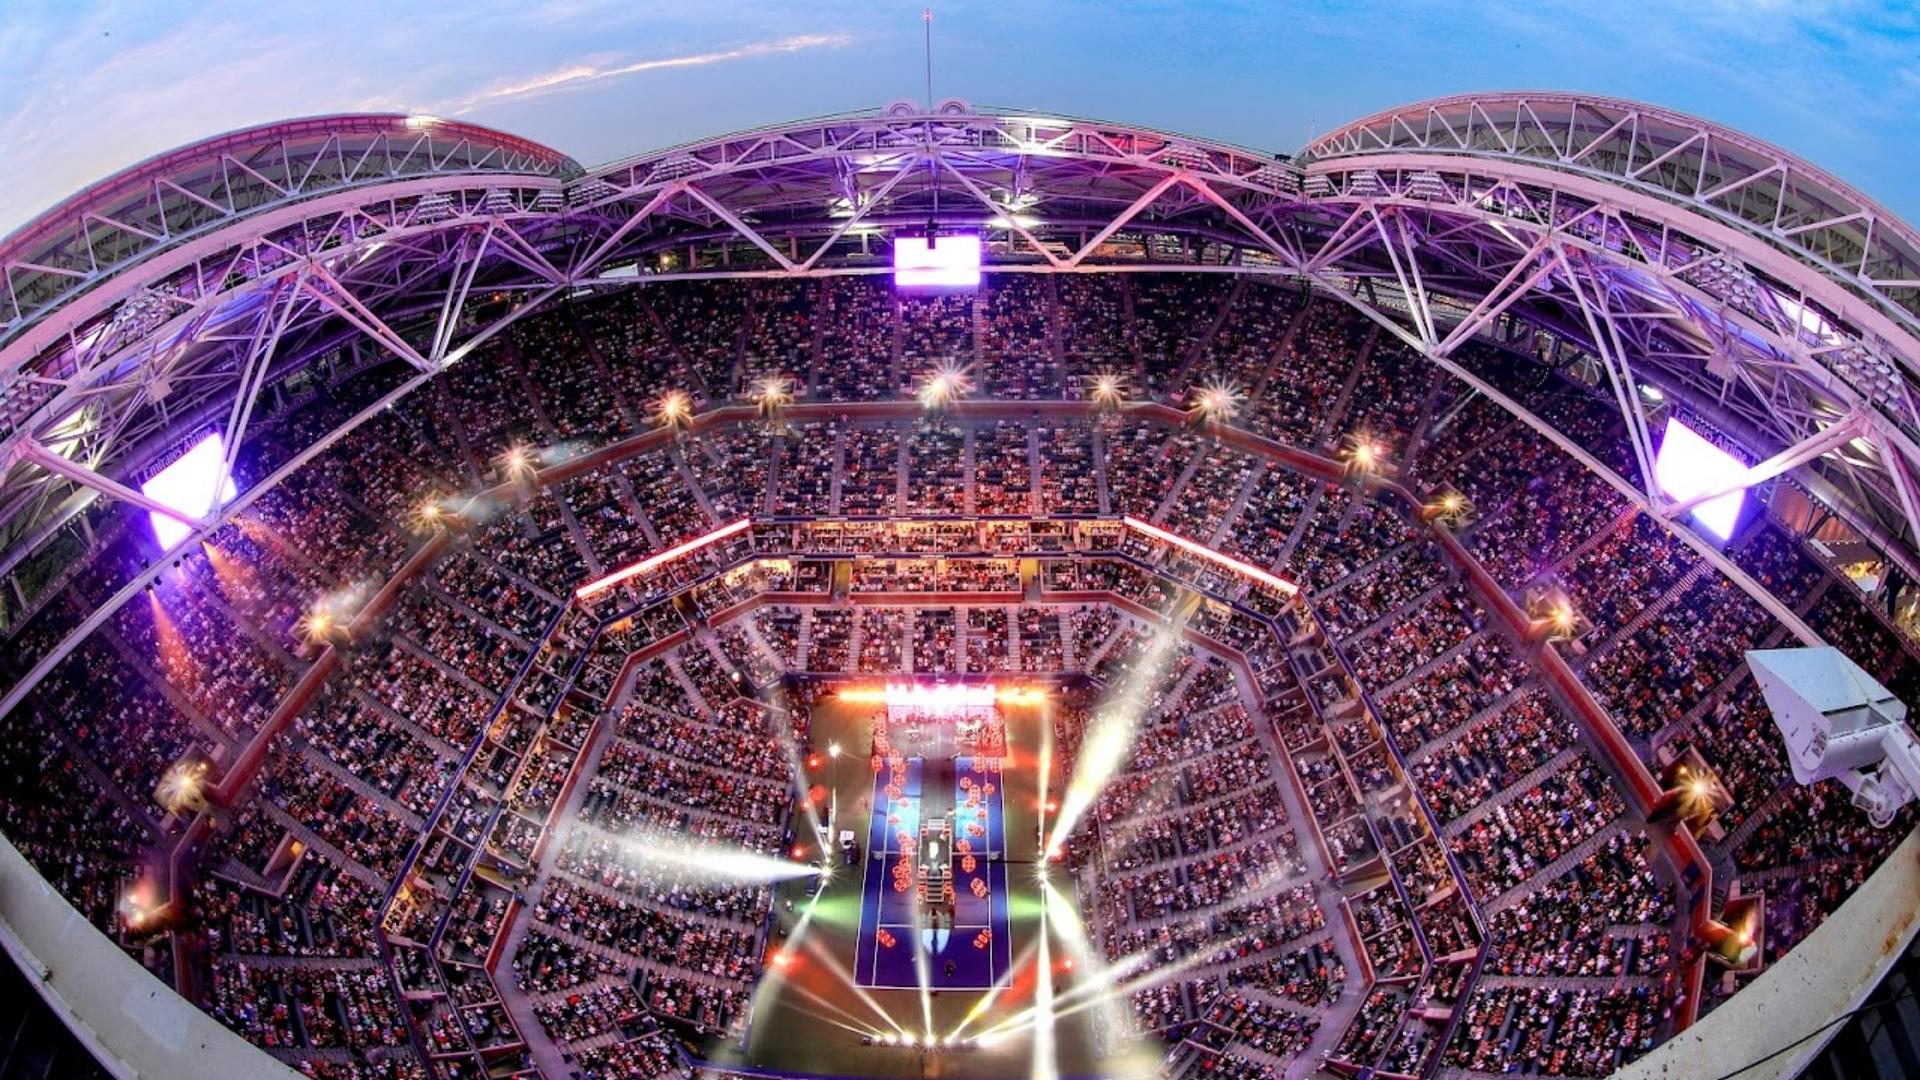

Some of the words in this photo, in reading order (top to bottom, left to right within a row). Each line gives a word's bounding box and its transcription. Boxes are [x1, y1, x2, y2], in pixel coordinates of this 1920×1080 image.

[1675, 406, 1713, 442] Emirates
[1714, 434, 1748, 463] Airline
[143, 446, 183, 481] Emirates
